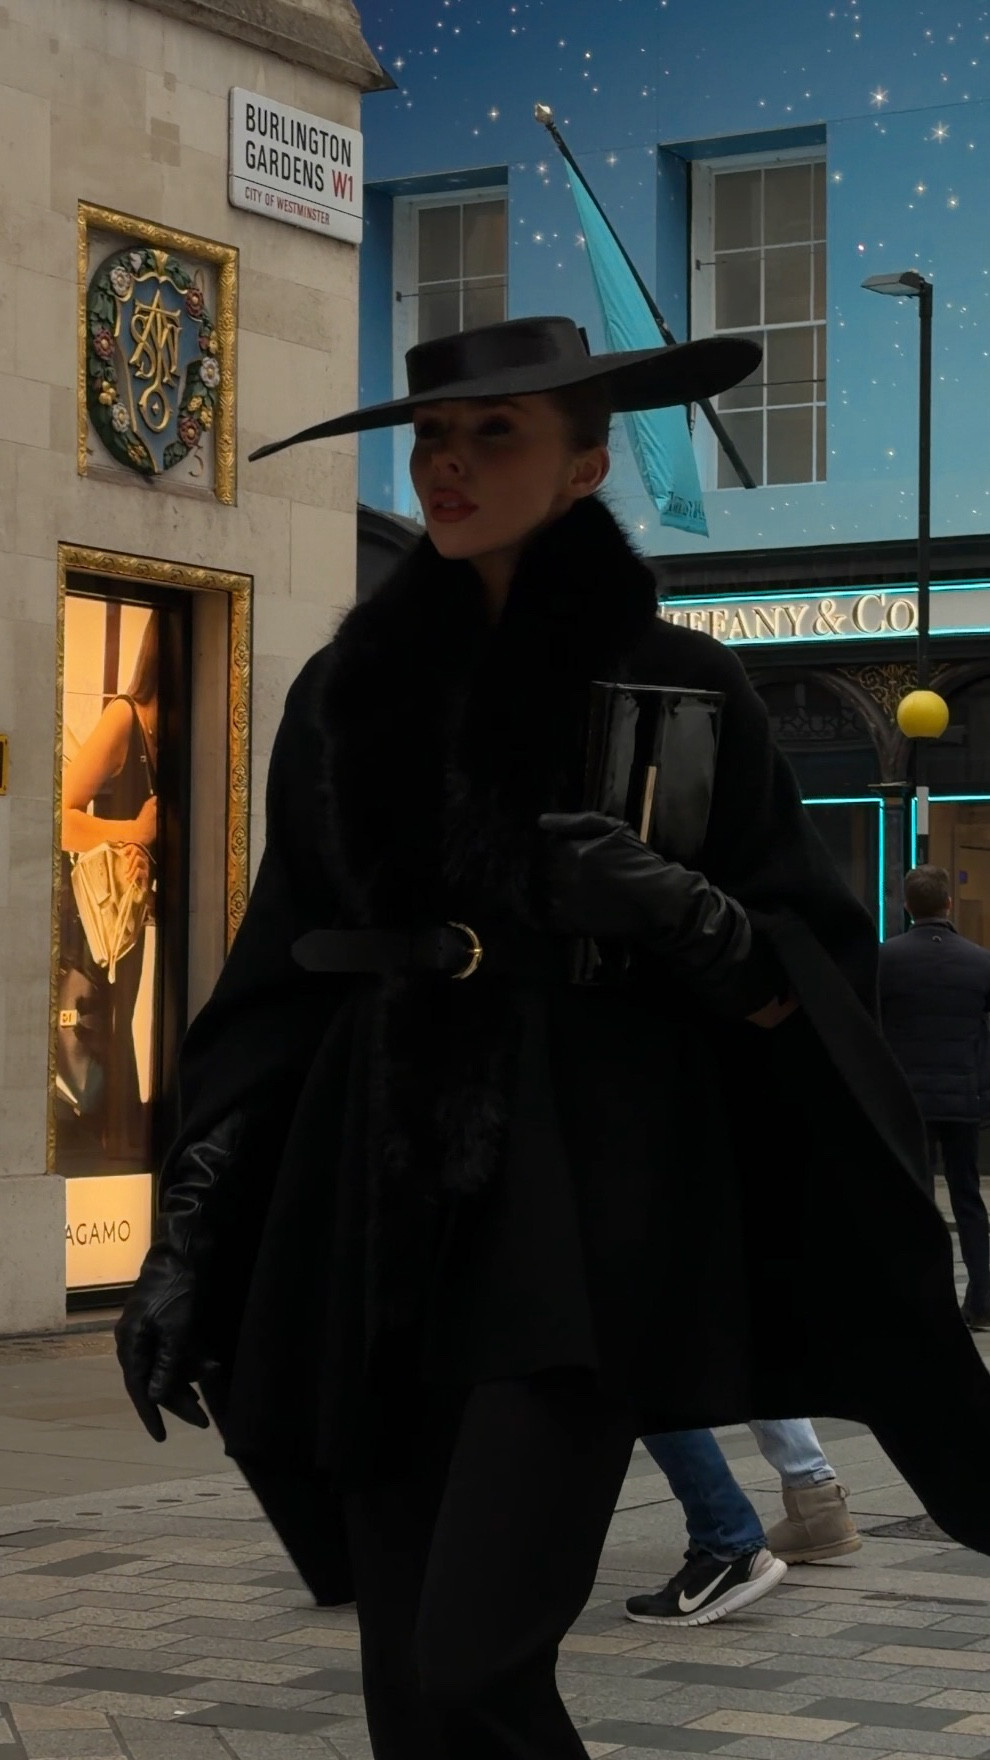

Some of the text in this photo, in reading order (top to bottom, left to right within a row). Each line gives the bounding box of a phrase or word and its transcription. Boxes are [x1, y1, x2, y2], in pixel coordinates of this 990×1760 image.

[245, 103, 351, 167] BURLINGTON
[245, 140, 353, 202] GARDENS W1
[245, 186, 330, 225] CITY OF WESTMINSTER
[852, 593, 919, 634] Co
